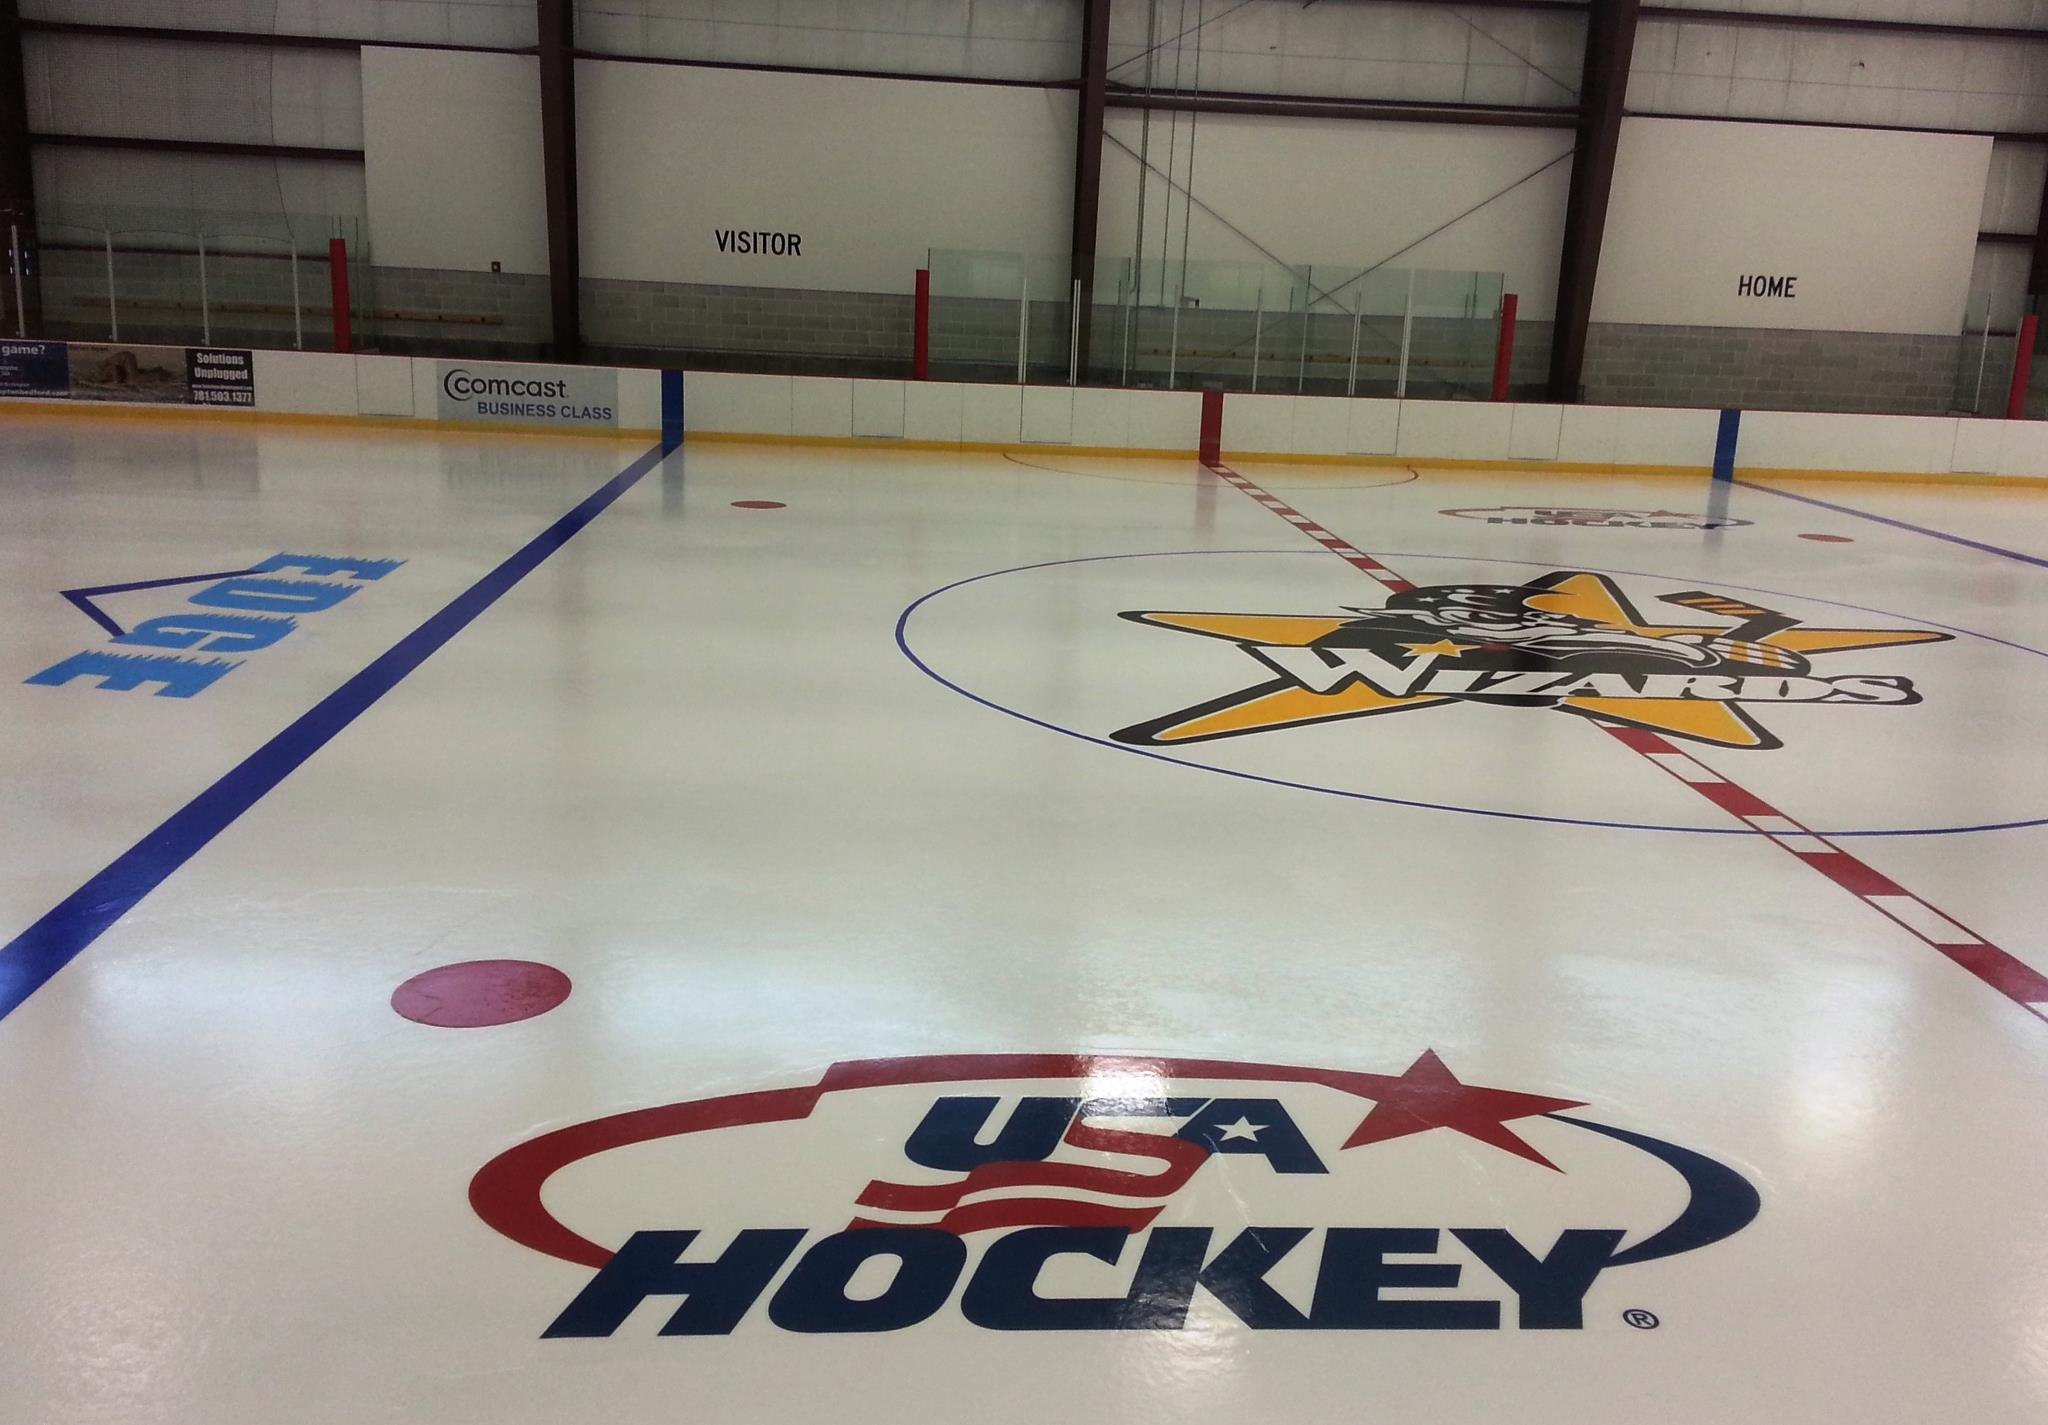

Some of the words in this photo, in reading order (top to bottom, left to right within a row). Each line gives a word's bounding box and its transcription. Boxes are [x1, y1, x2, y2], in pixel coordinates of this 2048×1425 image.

[715, 229, 802, 256] VISITOR
[1737, 275, 1798, 298] HOME
[1, 344, 46, 357] game?
[196, 352, 245, 365] Solutions
[194, 366, 248, 380] Unplugged
[478, 401, 556, 418] BUSINESS
[560, 405, 612, 420] CLASS
[22, 552, 409, 699] EDGE
[903, 1096, 1330, 1198] USA
[540, 1227, 1628, 1340] HOCKEY
